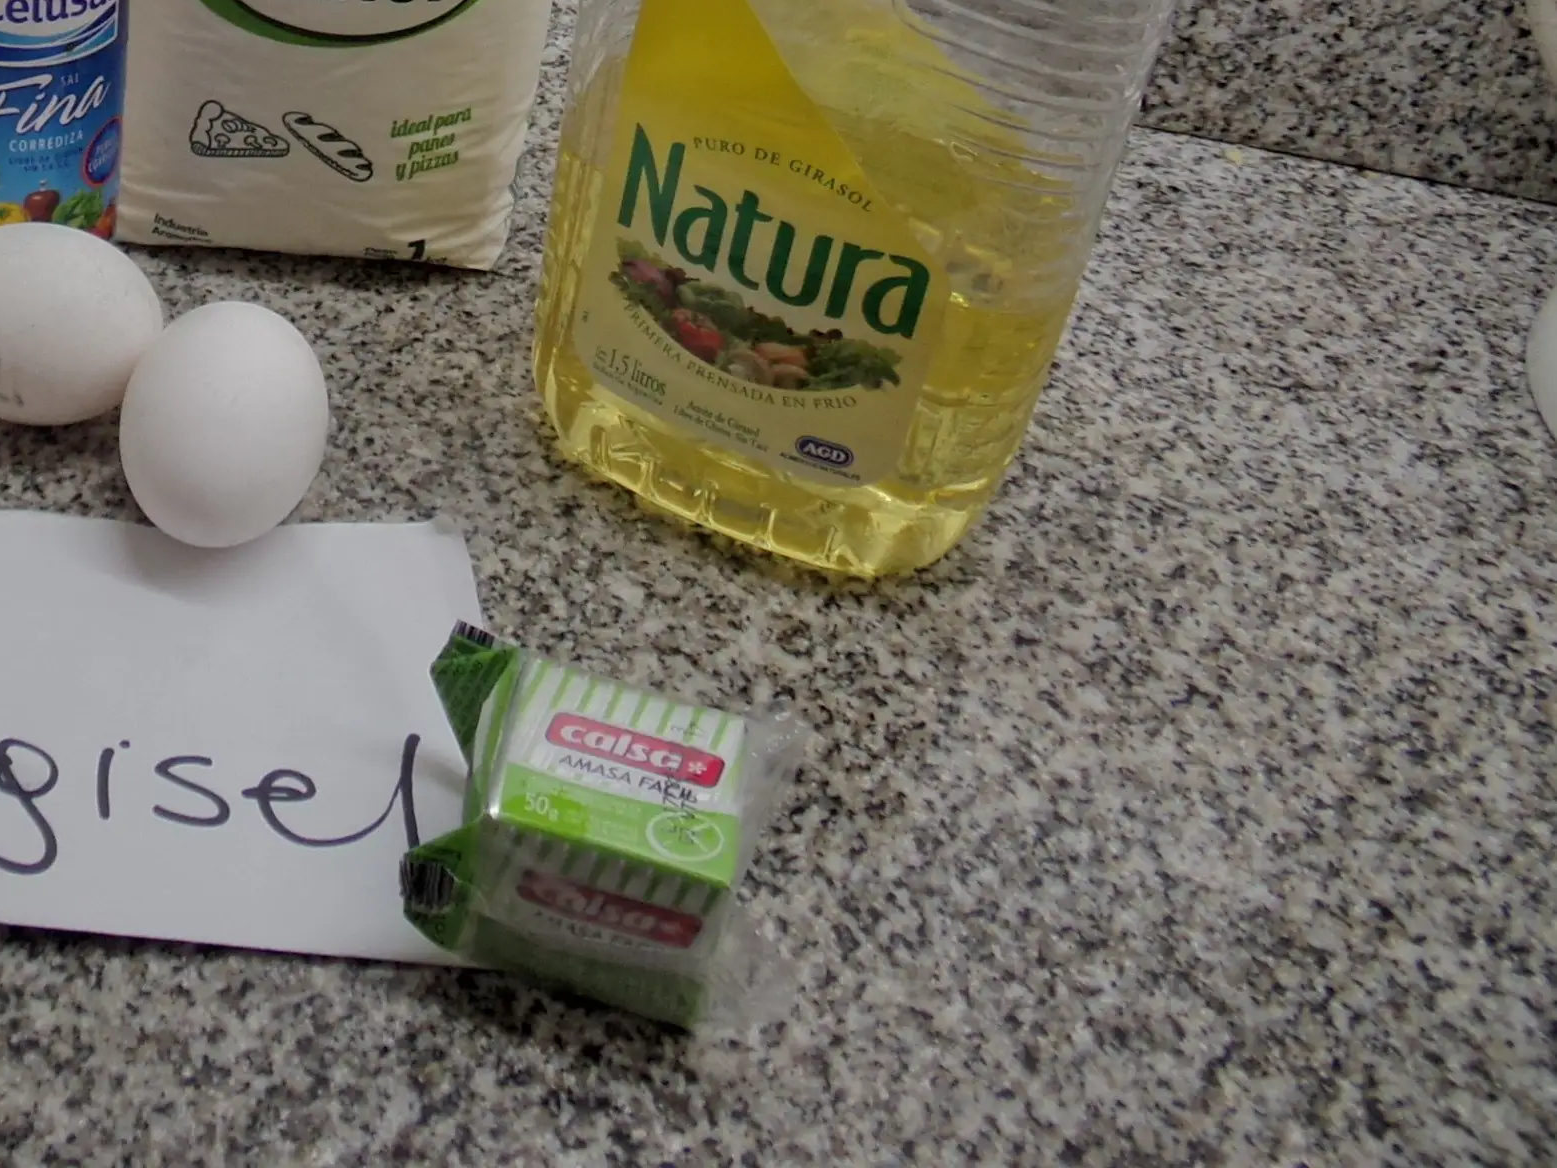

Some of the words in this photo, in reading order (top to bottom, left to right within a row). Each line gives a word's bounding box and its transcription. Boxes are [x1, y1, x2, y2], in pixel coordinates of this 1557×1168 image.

[390, 113, 433, 138] ideal
[432, 106, 473, 132] para
[8, 130, 84, 153] CORREDIZA
[407, 133, 456, 160] panes
[394, 163, 407, 182] y
[407, 150, 460, 180] pizzas
[692, 136, 746, 158] PURO
[753, 146, 782, 168] DE
[788, 158, 874, 214] GIRASOL
[616, 122, 931, 340] Natura
[624, 302, 682, 363] PRIMERA
[686, 361, 775, 407] PRENSADA
[782, 395, 806, 410] EN
[802, 442, 846, 462] AGD
[560, 722, 685, 771] calsa
[558, 753, 632, 786] AMASA
